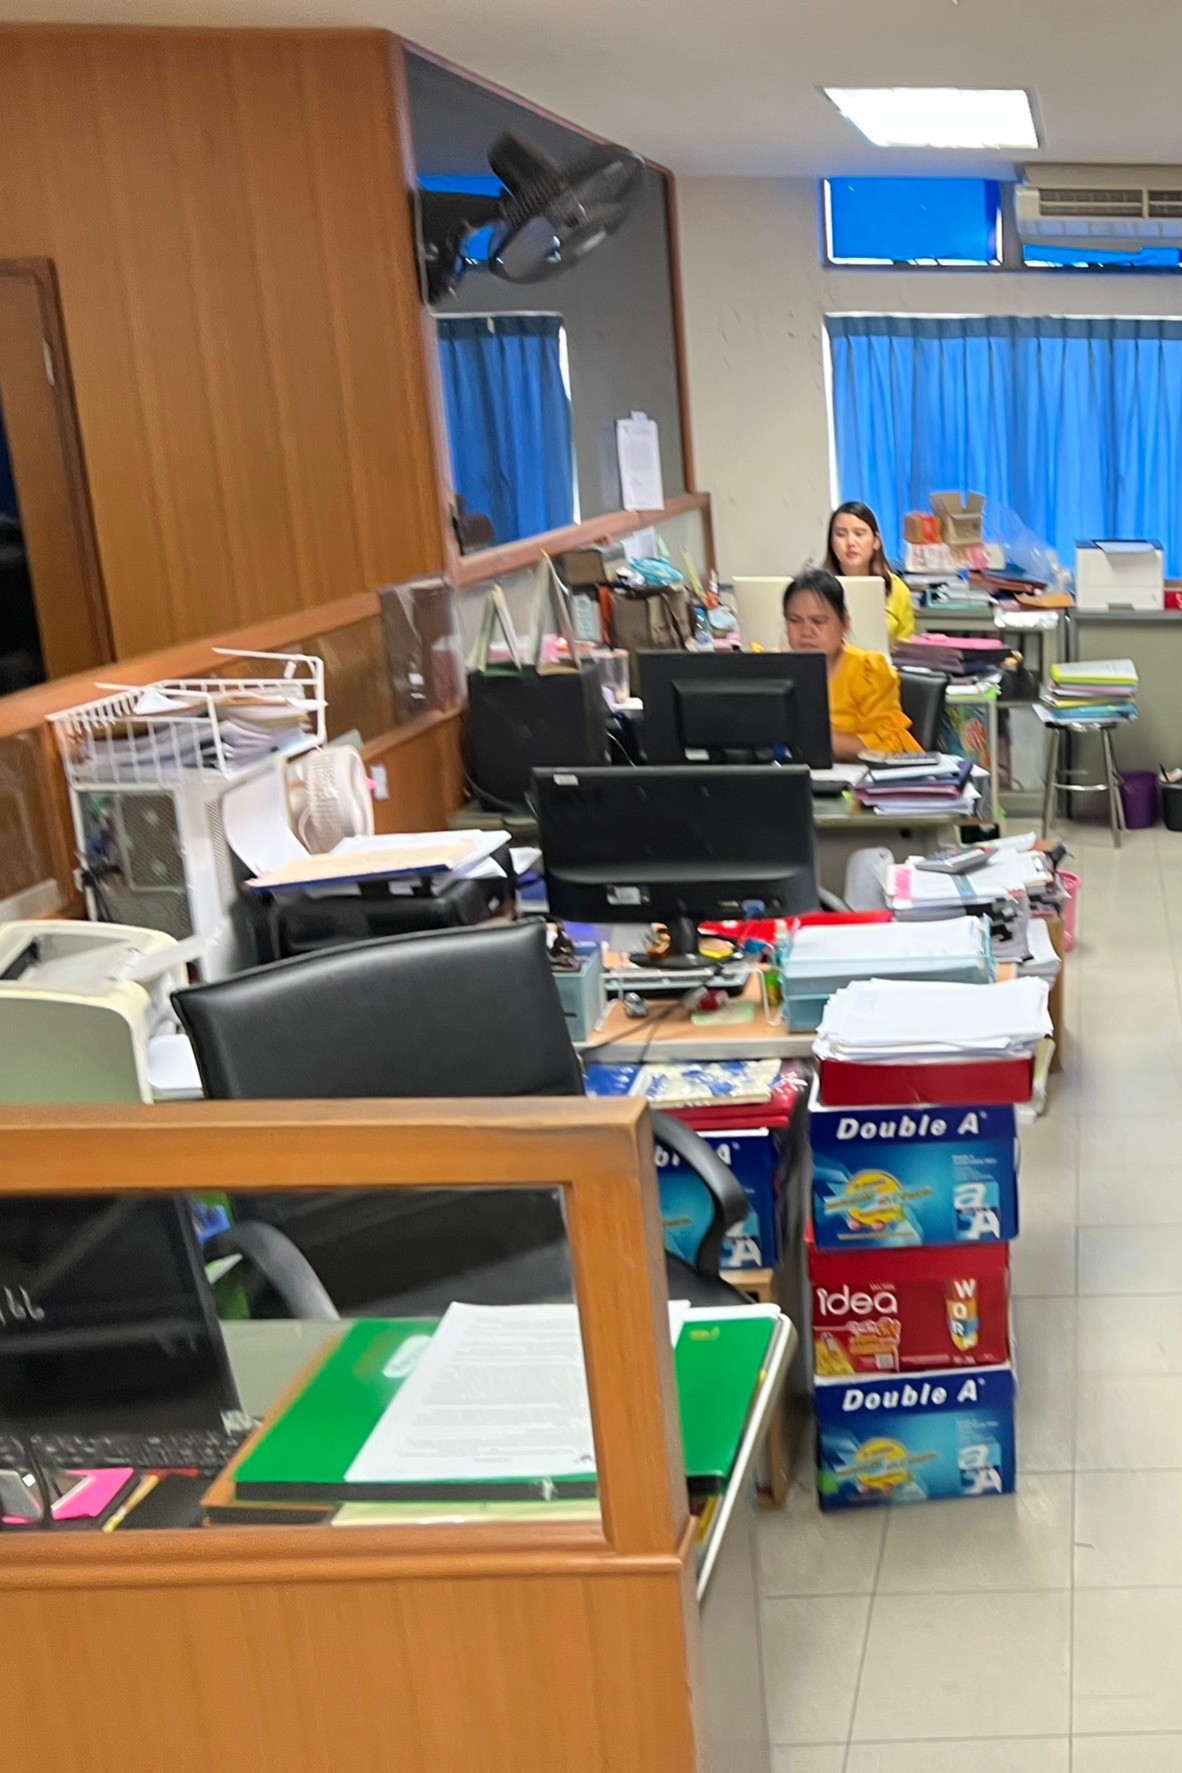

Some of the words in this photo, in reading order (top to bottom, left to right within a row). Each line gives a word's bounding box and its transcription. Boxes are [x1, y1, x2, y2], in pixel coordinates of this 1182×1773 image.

[836, 1114, 947, 1140] Double
[957, 1112, 980, 1135] A
[842, 1383, 948, 1412] Double
[956, 1379, 979, 1402] A
